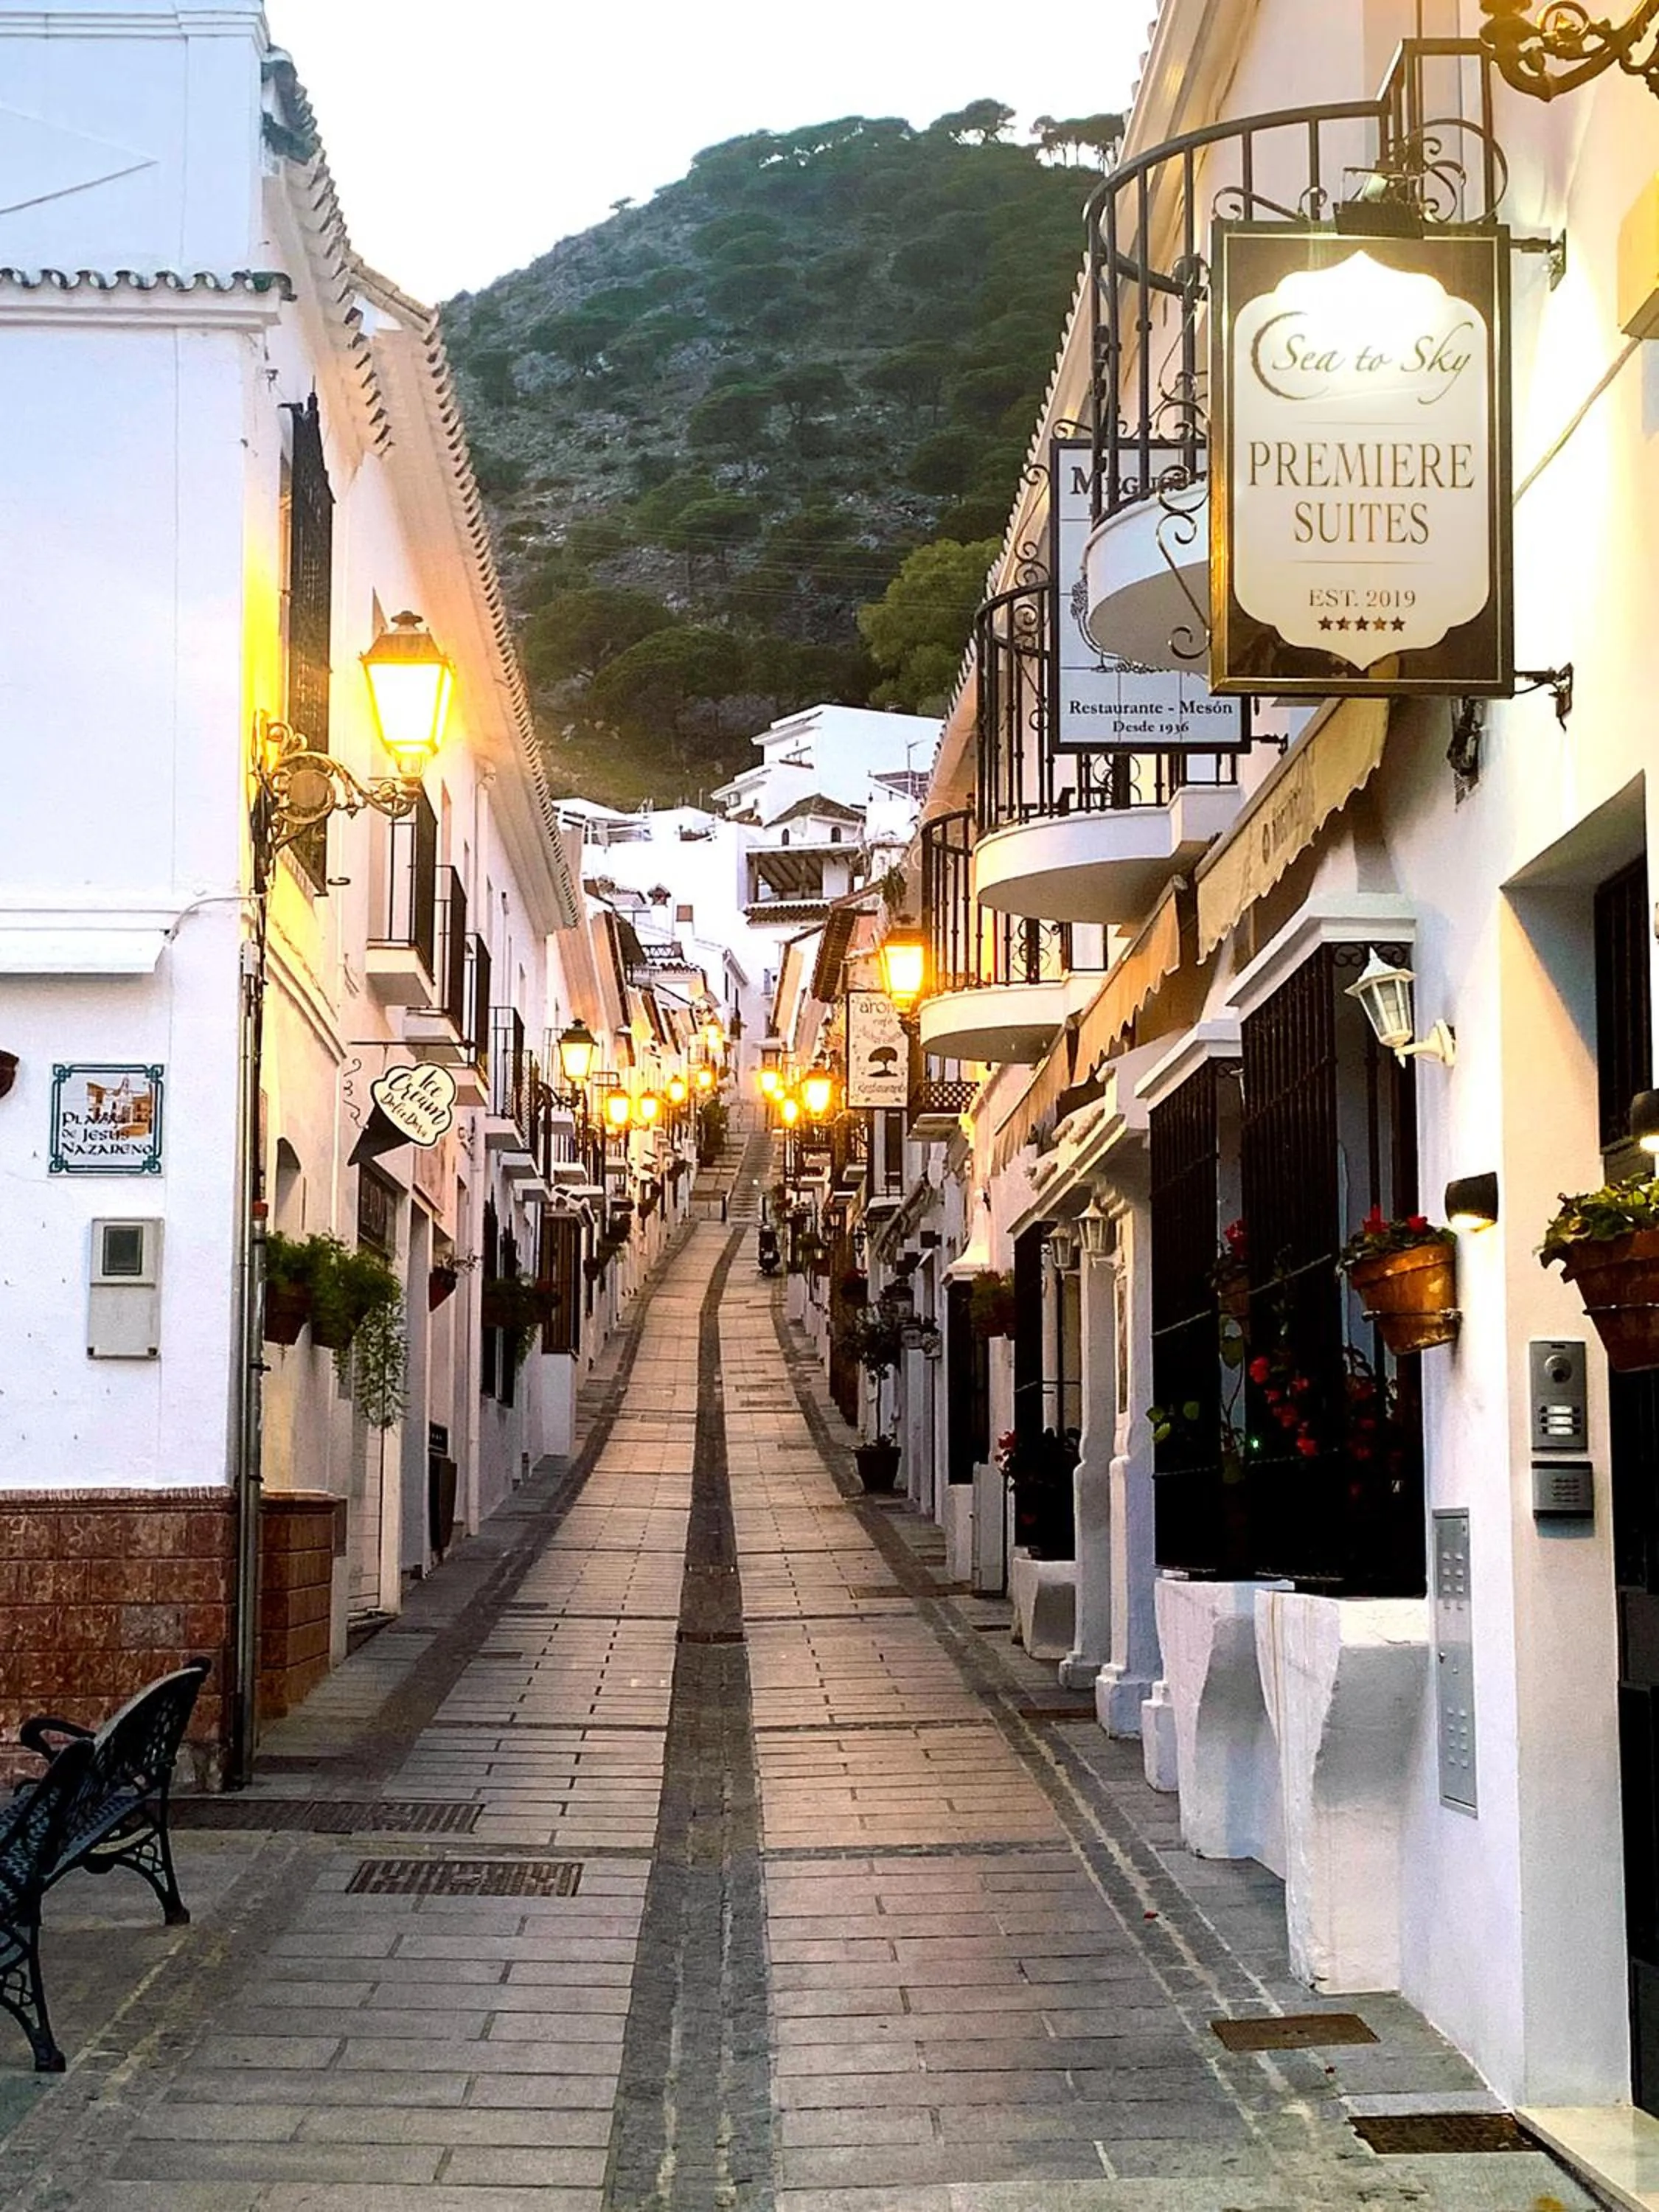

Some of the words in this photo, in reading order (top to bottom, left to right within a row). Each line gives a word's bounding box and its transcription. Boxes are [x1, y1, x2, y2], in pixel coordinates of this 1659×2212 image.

[1272, 333, 1346, 372] Sea
[1355, 345, 1391, 372] to
[1400, 322, 1474, 405] Sky
[1248, 441, 1475, 490] PREMIERE
[1294, 501, 1430, 546] SUITES
[1309, 589, 1358, 608] EST.
[1366, 590, 1416, 609] 2019
[1069, 700, 1163, 714] Restaurante
[1180, 700, 1233, 714] Mesón
[1113, 720, 1155, 733] Desde
[1159, 720, 1189, 735] 1936
[389, 1073, 446, 1126] Cream
[419, 1070, 442, 1098] Ice
